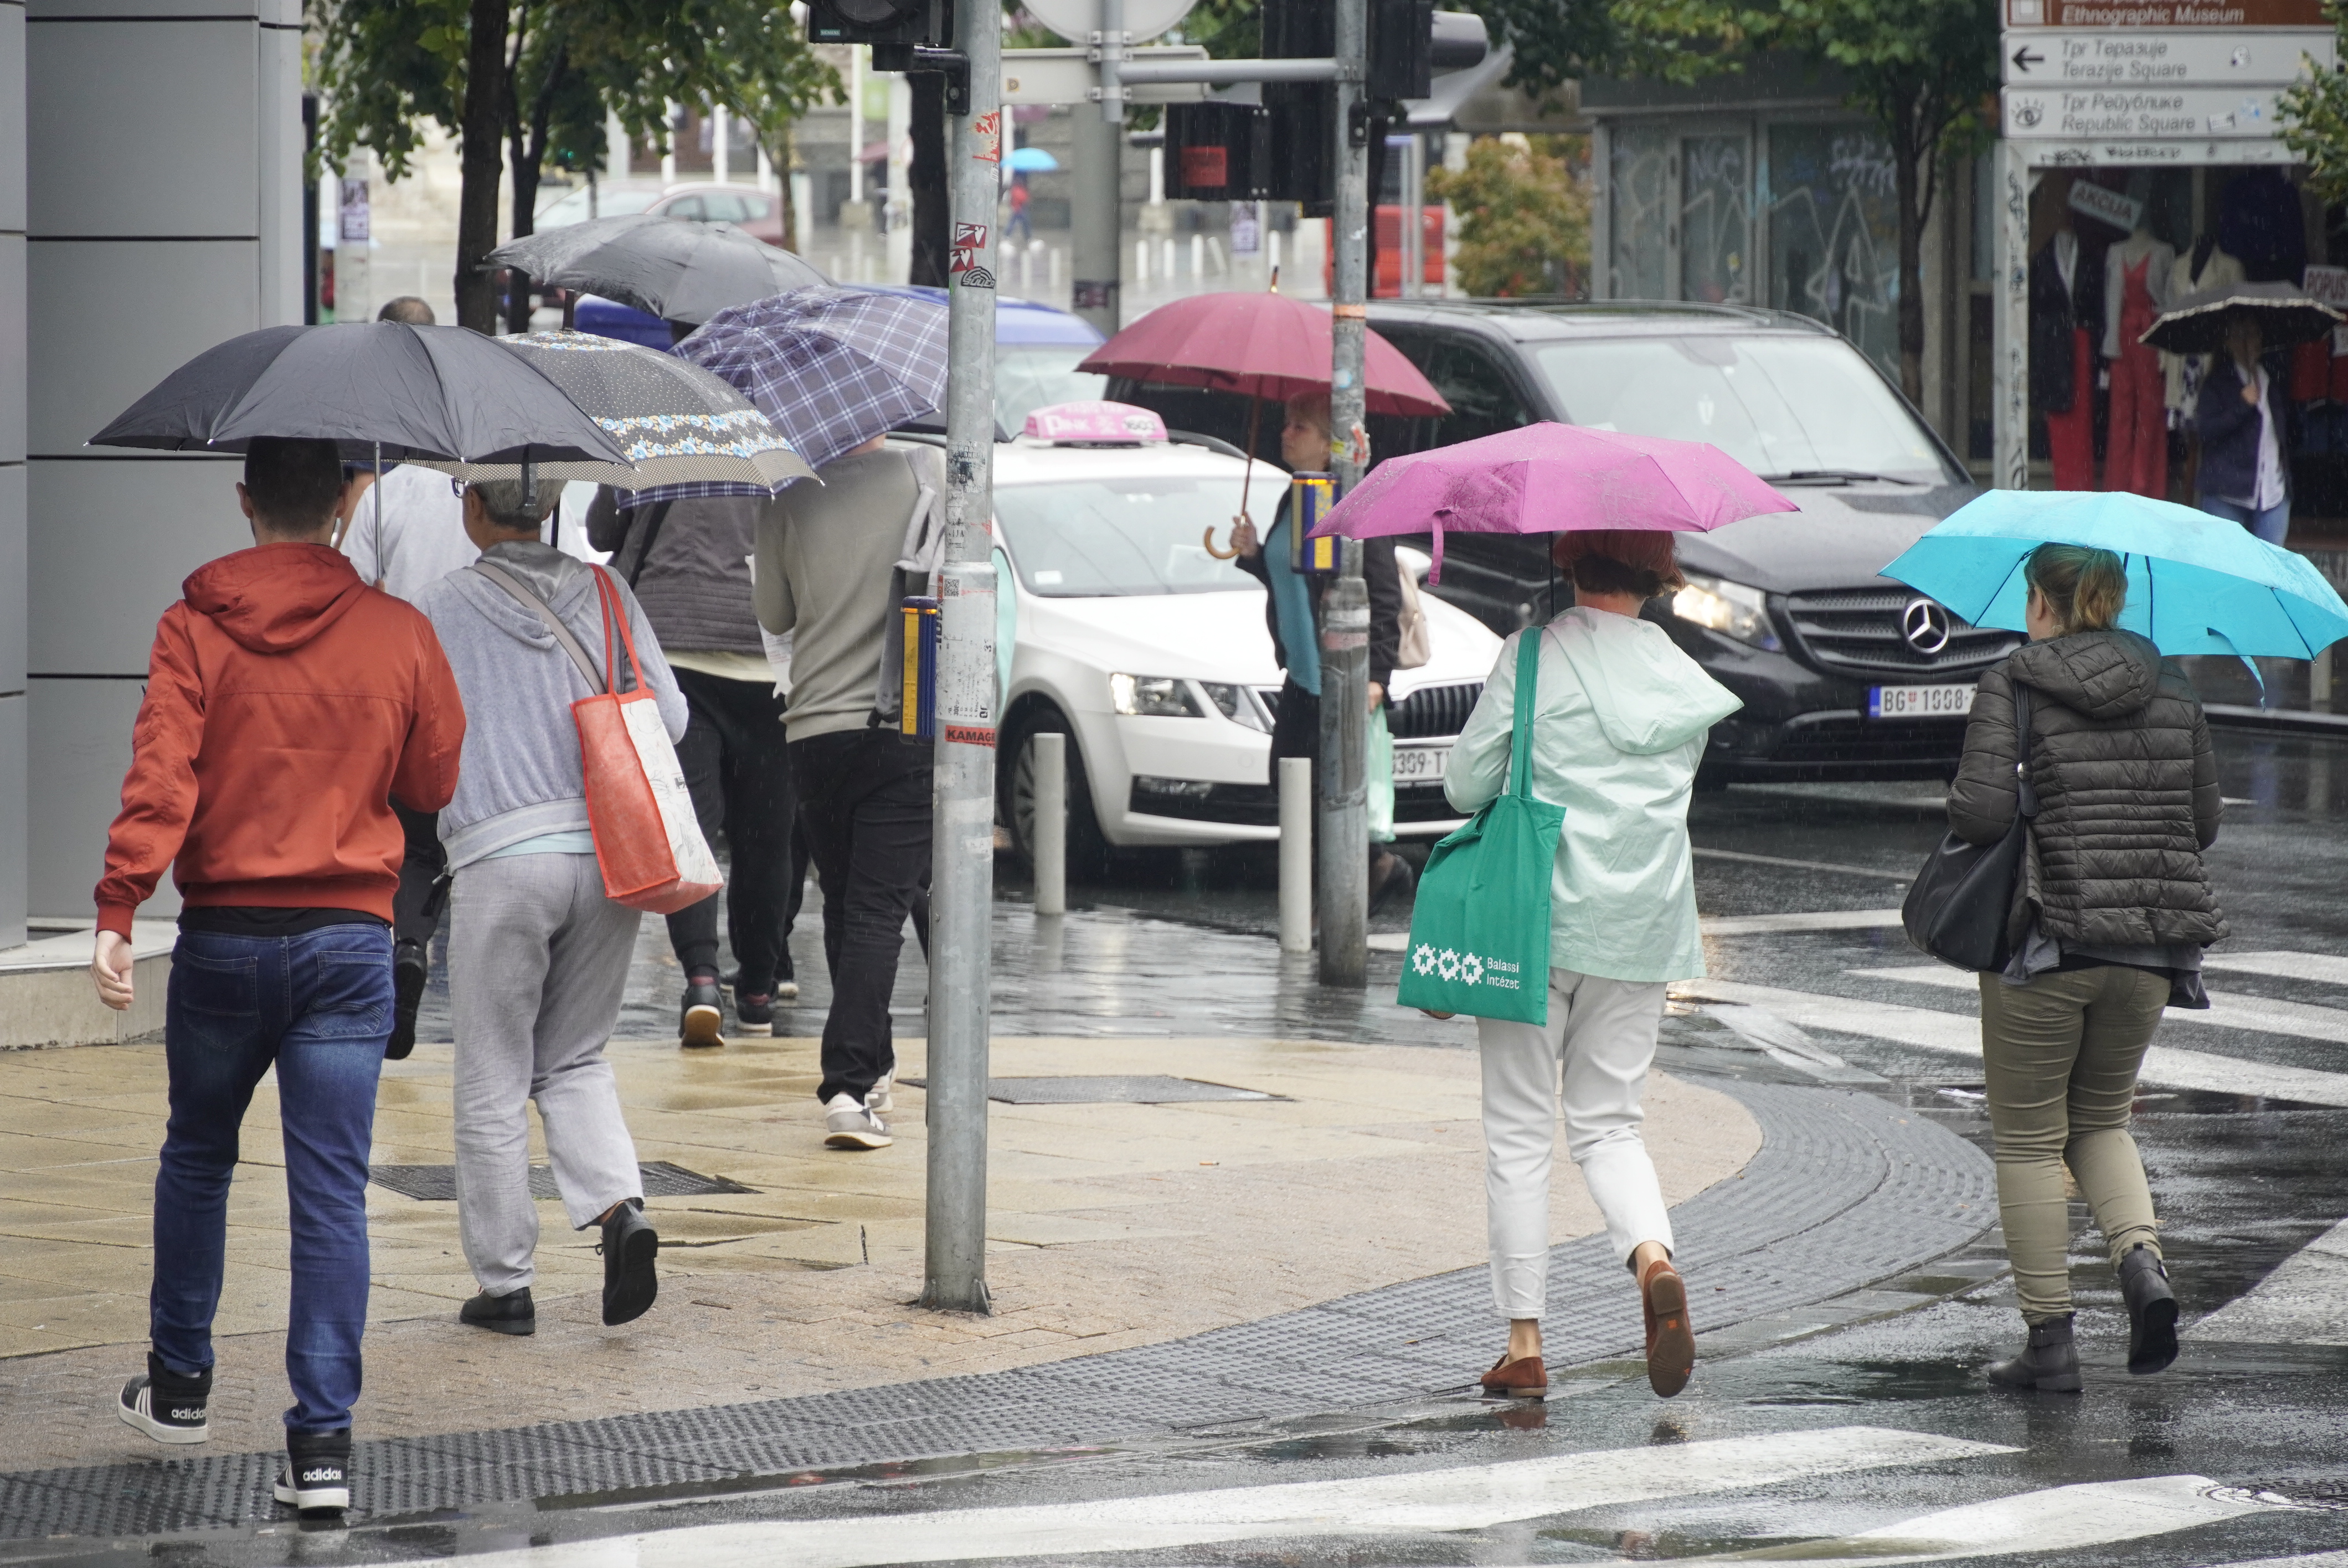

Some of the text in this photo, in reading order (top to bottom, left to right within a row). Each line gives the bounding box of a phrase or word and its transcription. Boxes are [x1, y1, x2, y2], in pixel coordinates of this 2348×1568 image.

[2061, 4, 2244, 27] Ethnographic Museum
[2062, 59, 2187, 82] Terazije Square
[2061, 114, 2196, 137] Republic Square
[1884, 690, 1905, 712] BG
[1487, 957, 1519, 973] Balassi
[1487, 973, 1520, 990] Intézet
[302, 1467, 342, 1481] adidas
